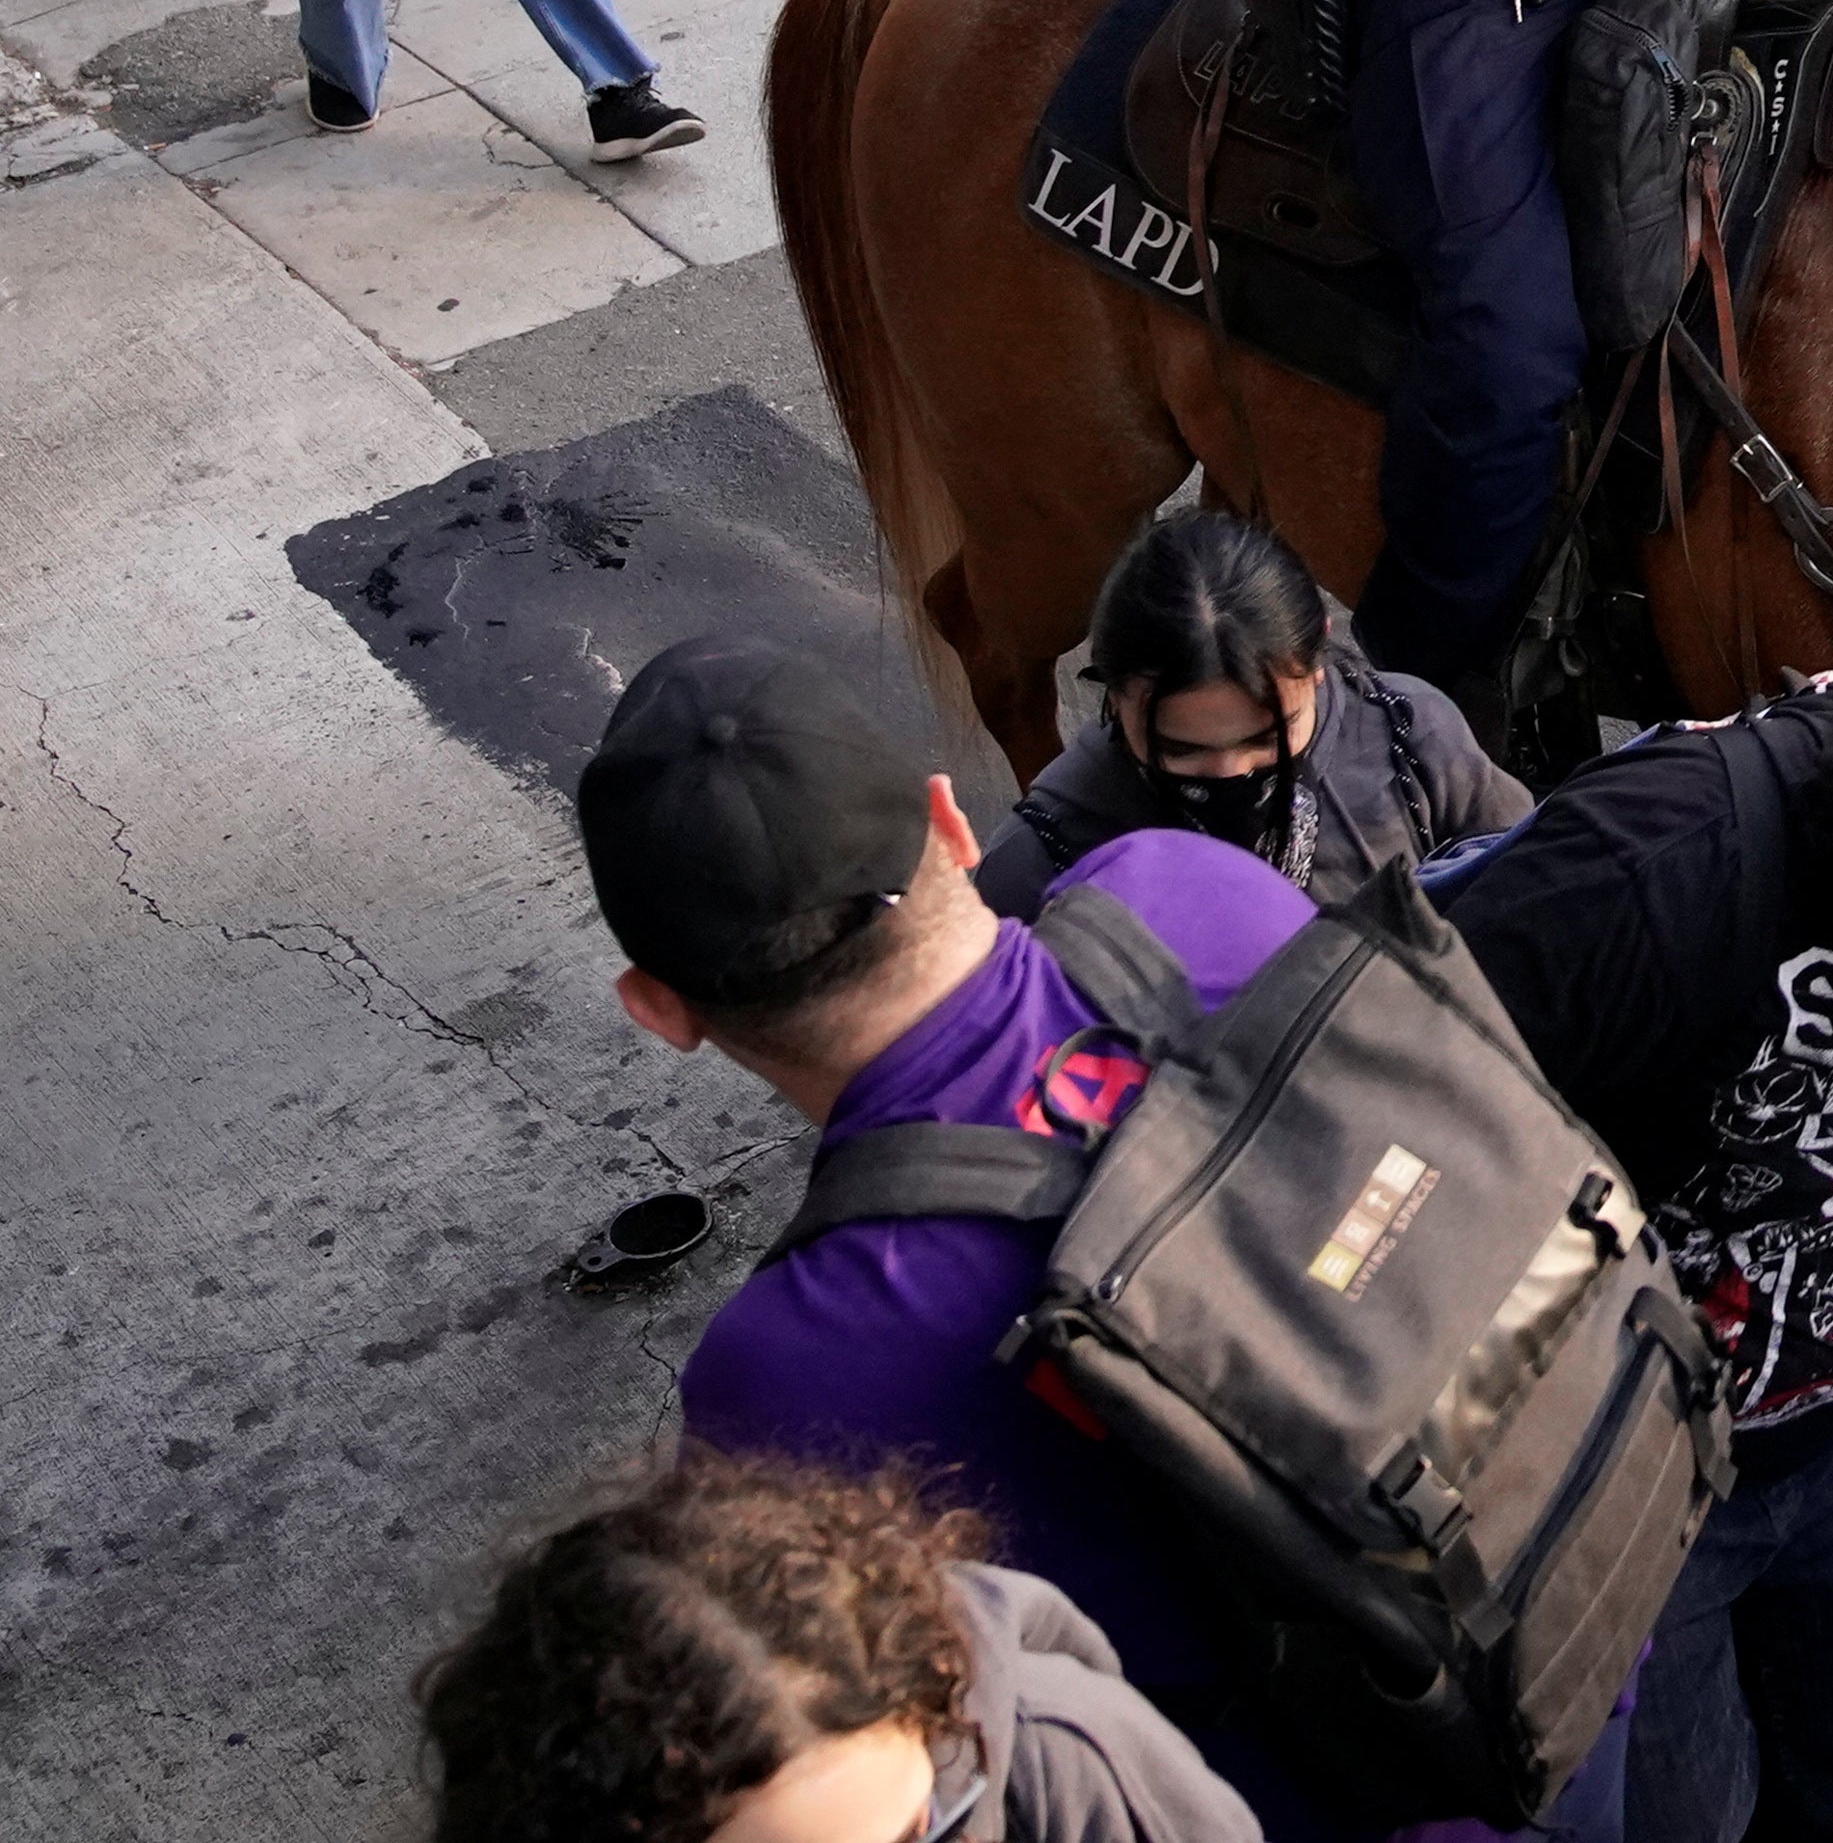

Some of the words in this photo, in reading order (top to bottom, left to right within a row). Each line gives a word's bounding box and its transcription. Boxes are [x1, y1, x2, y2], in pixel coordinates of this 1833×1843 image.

[1028, 149, 1219, 296] LAPD
[1346, 1236, 1398, 1303] LIVING
[1389, 1168, 1441, 1234] SPACES
